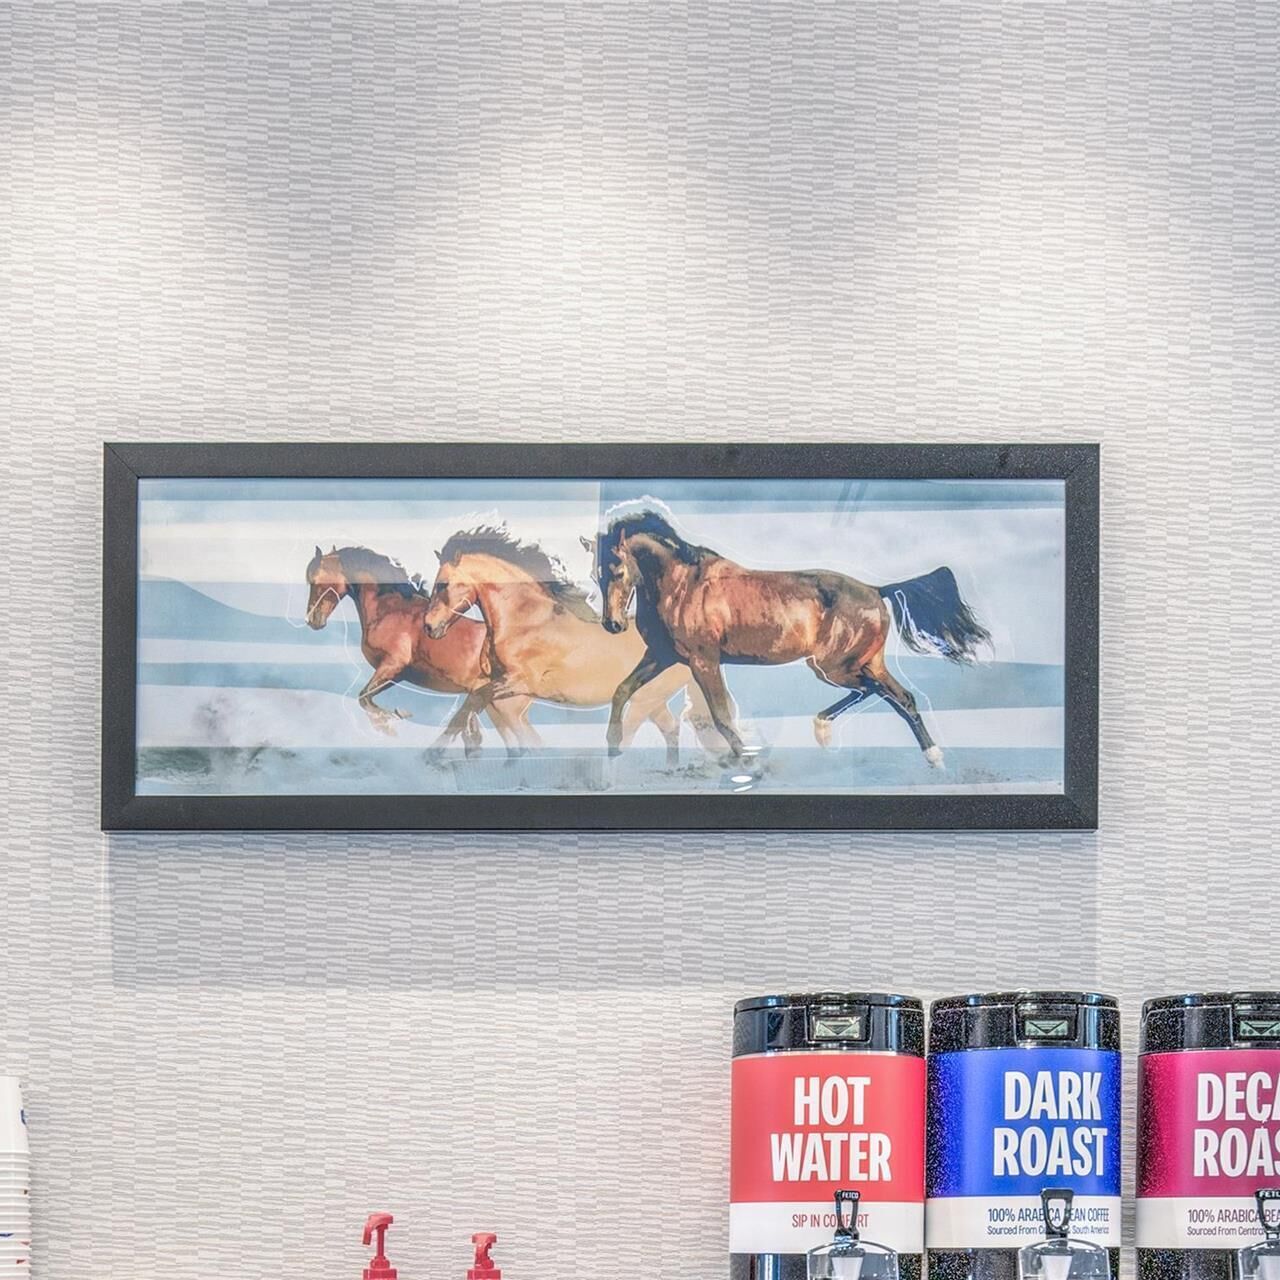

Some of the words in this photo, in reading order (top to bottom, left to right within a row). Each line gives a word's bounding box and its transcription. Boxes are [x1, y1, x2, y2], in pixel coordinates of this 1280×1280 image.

[794, 1075, 871, 1126] HOT
[1004, 1071, 1102, 1120] DARK
[770, 1132, 892, 1182] WATER
[993, 1126, 1108, 1176] ROAST
[792, 1213, 808, 1228] SIP
[810, 1213, 820, 1228] IN
[823, 1213, 870, 1228] COFRT
[988, 1208, 1016, 1222] 100%
[1017, 1208, 1061, 1222] ARABCA
[1066, 1208, 1086, 1221] EAN
[1087, 1208, 1110, 1222] COFFEE
[1188, 1209, 1215, 1223] 100%
[987, 1225, 1018, 1235] Sourced
[1019, 1225, 1038, 1235] From
[1187, 1226, 1217, 1236] Sourced
[1218, 1226, 1237, 1236] From
[1238, 1226, 1266, 1236] Centra
